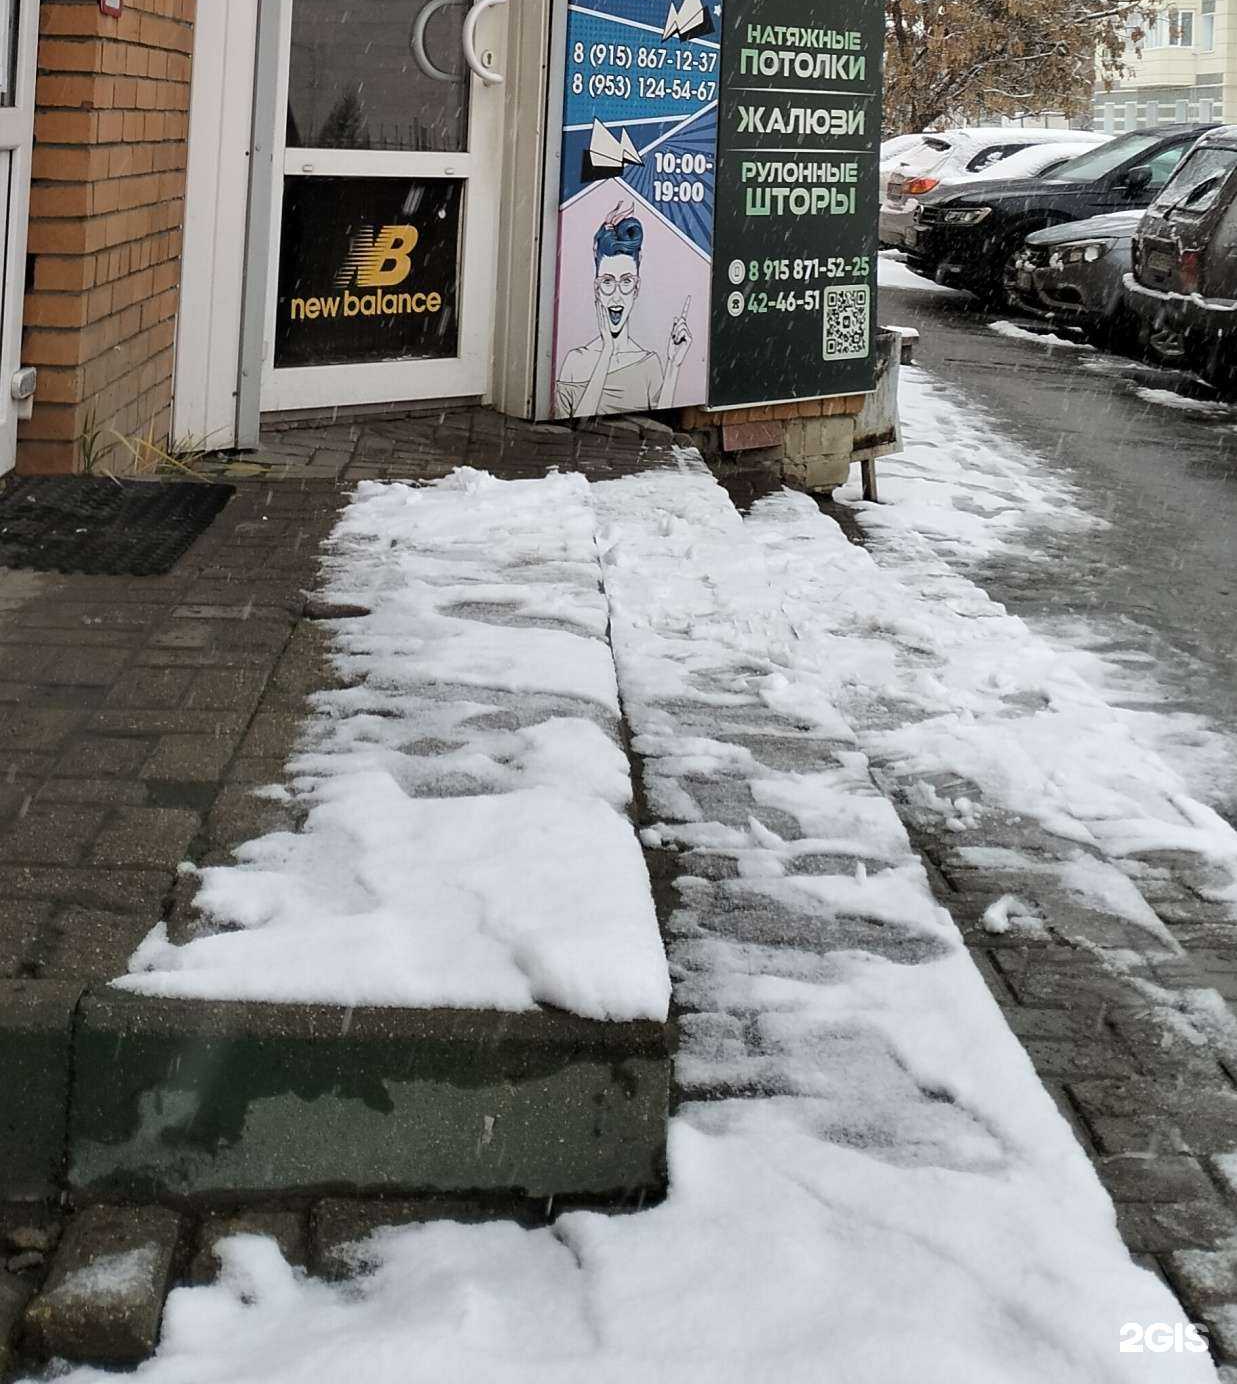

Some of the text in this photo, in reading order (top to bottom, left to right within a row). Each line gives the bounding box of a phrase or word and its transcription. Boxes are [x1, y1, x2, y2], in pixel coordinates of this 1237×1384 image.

[747, 23, 861, 50] НАТЯЖНЫЕ
[573, 42, 717, 73] 8 (915) 867-12-37
[740, 48, 865, 81] ПОТОЛКИ
[572, 73, 716, 101] 8 (953) 124-54-67
[737, 106, 864, 135] ЖАЛЮЗИ
[654, 152, 713, 174] 10:00-
[742, 162, 858, 183] РУЛОННЫЕ
[653, 181, 704, 202] 19:00
[746, 187, 856, 216] ШТОРЫ
[748, 256, 870, 281] 8 915 871-52-25
[290, 289, 442, 320] new balance
[747, 290, 820, 313] 42-46-51
